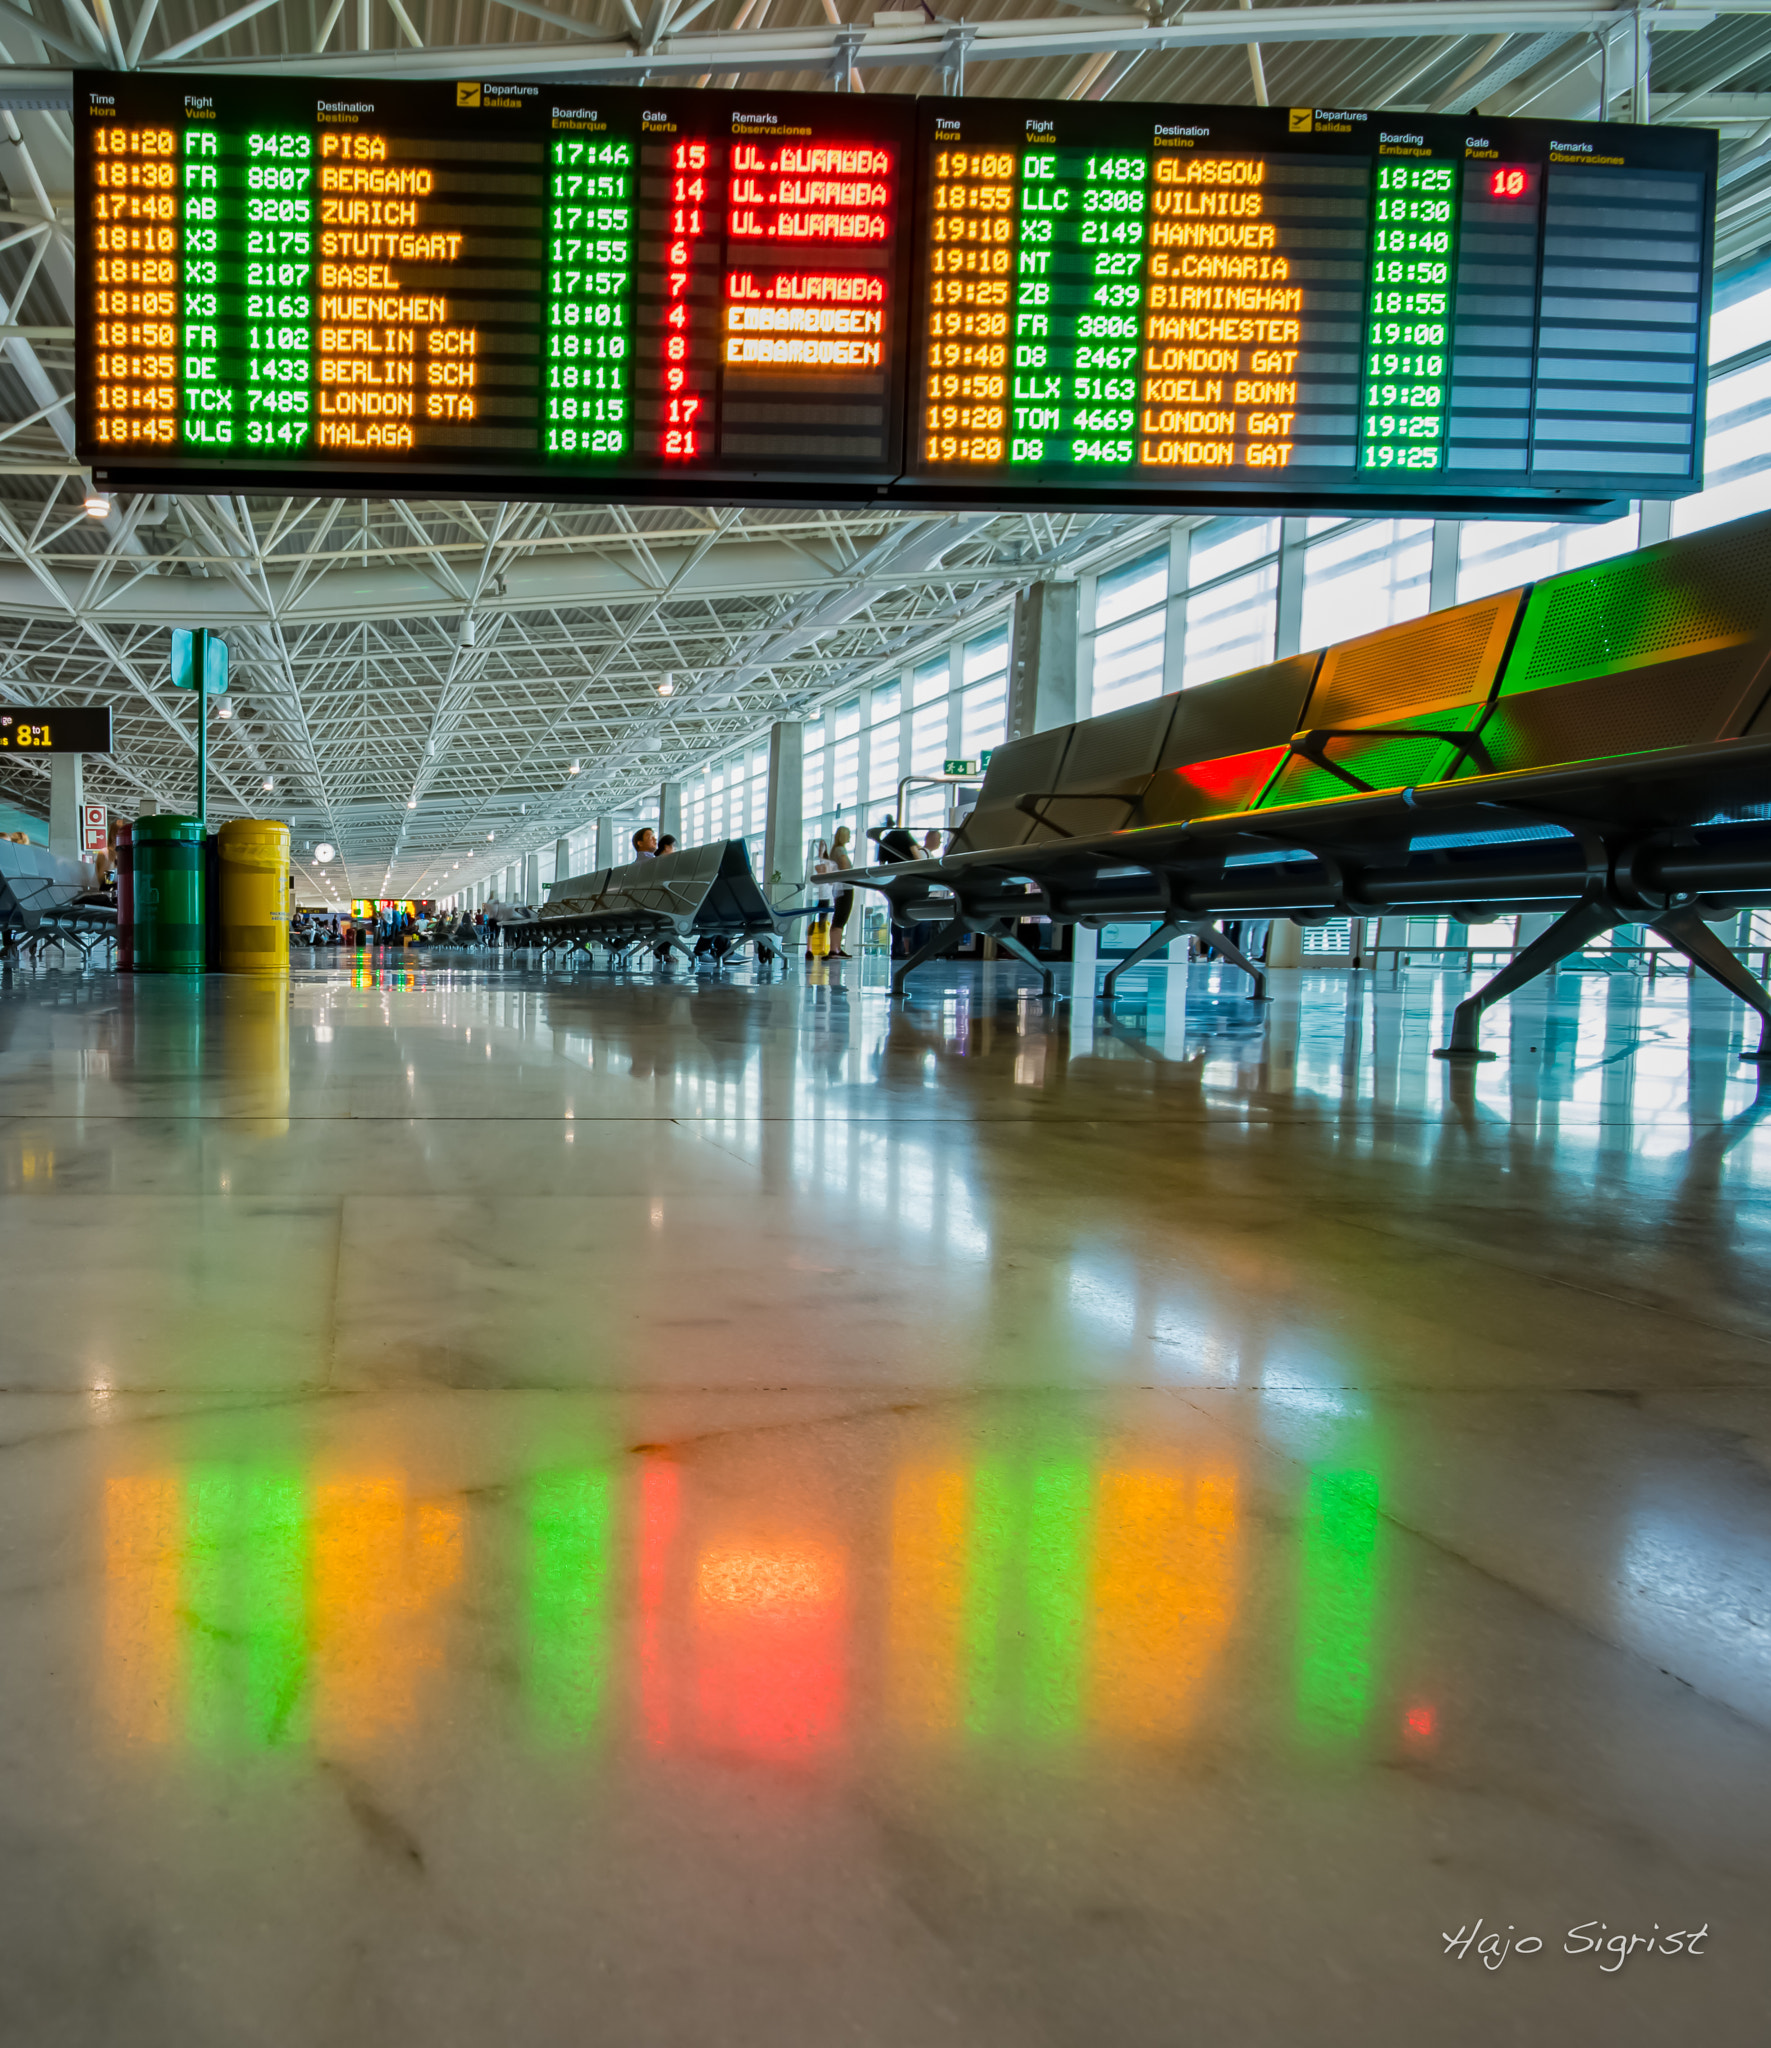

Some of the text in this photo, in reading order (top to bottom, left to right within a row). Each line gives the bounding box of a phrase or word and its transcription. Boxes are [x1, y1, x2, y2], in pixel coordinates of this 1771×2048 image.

[483, 83, 539, 96] Departures
[89, 93, 115, 105] Time
[184, 95, 213, 109] Flight
[317, 100, 375, 112] Destination
[483, 97, 522, 108] Salidas
[89, 106, 116, 117] Hora
[185, 108, 216, 119] Vuelo
[317, 111, 359, 123] Destino
[552, 107, 598, 121] Boarding
[642, 110, 667, 122] Gate
[732, 112, 778, 124] Remarks
[1315, 109, 1368, 122] Departures
[551, 118, 607, 132] Embarque
[642, 121, 677, 133] Puerta
[732, 124, 811, 136] Observaciones
[935, 118, 961, 130] Time
[1025, 119, 1054, 133] Flight
[1154, 124, 1210, 136] Destination
[1315, 122, 1352, 132] Salidas
[934, 130, 961, 141] Hora
[1026, 132, 1057, 144] Vuelo
[1153, 136, 1195, 148] Destino
[1380, 132, 1424, 146] Boarding
[1465, 137, 1489, 148] Gate
[98, 130, 706, 170] 18:20 FR 9423 PISA 17:46 15
[1379, 144, 1432, 157] Embarque
[1465, 147, 1499, 159] Puerta
[1550, 140, 1593, 152] Remarks
[1549, 152, 1625, 165] Observaciones
[939, 154, 1524, 195] 19:00 DE 1483 GLASGOW 18:25 10
[98, 164, 174, 186] 18:30
[185, 164, 217, 188] FR
[248, 166, 310, 191] 8807
[322, 169, 432, 193] BERGAMO
[554, 175, 624, 197] 17:51
[675, 177, 704, 202] 14
[936, 186, 1450, 222] 18:55 LLC 3308 VILNIUS 18:30
[97, 195, 701, 234] 17:40 AB 3205 ZURICH 17:55 11
[935, 218, 1449, 253] 19:10 X3 2149 HANNOVER 18:40
[97, 227, 687, 265] 18:10 X3 2175 STUTTGART 17:55 6
[934, 250, 1448, 284] 19:10 NT 227 G.CANARIA 18:50
[98, 260, 687, 297] 18:20 X3 2107 BASEL 17:57 7
[933, 281, 1008, 304] 19:25
[1018, 282, 1050, 305] ZB
[1093, 284, 1140, 307] 439
[1374, 291, 1446, 315] 18:55
[98, 291, 686, 329] 18:05 X3 2163 MUENCHEN 18:01 4
[932, 313, 1445, 346] 19:30 FR 3806 MANCHESTER 19:00
[98, 323, 685, 360] 18:50 FR 1102 BERLIN SCH 18:10 8
[931, 344, 1443, 377] 19:40 D8 2467 LONDON GAT 19:10
[98, 355, 684, 391] 18:35 DE 1433 BERLIN SCH 18:11 9
[929, 375, 1441, 407] 19:50 LLX 5163 KOELN BONN 19:20
[98, 387, 699, 423] 18:45 TCX 7485 LONDON STA 18:15 17
[929, 407, 1440, 438] 19:20 TOM 4669 LONDON GAT 19:25
[98, 418, 695, 454] 18:45 VLG 3147 MALAGA 18:20 21
[927, 437, 1438, 469] 19:20 D8 9465 LONDON GAT 19:25
[16, 724, 32, 746] 8
[32, 725, 41, 734] to
[40, 725, 52, 746] 1
[33, 737, 40, 746] a
